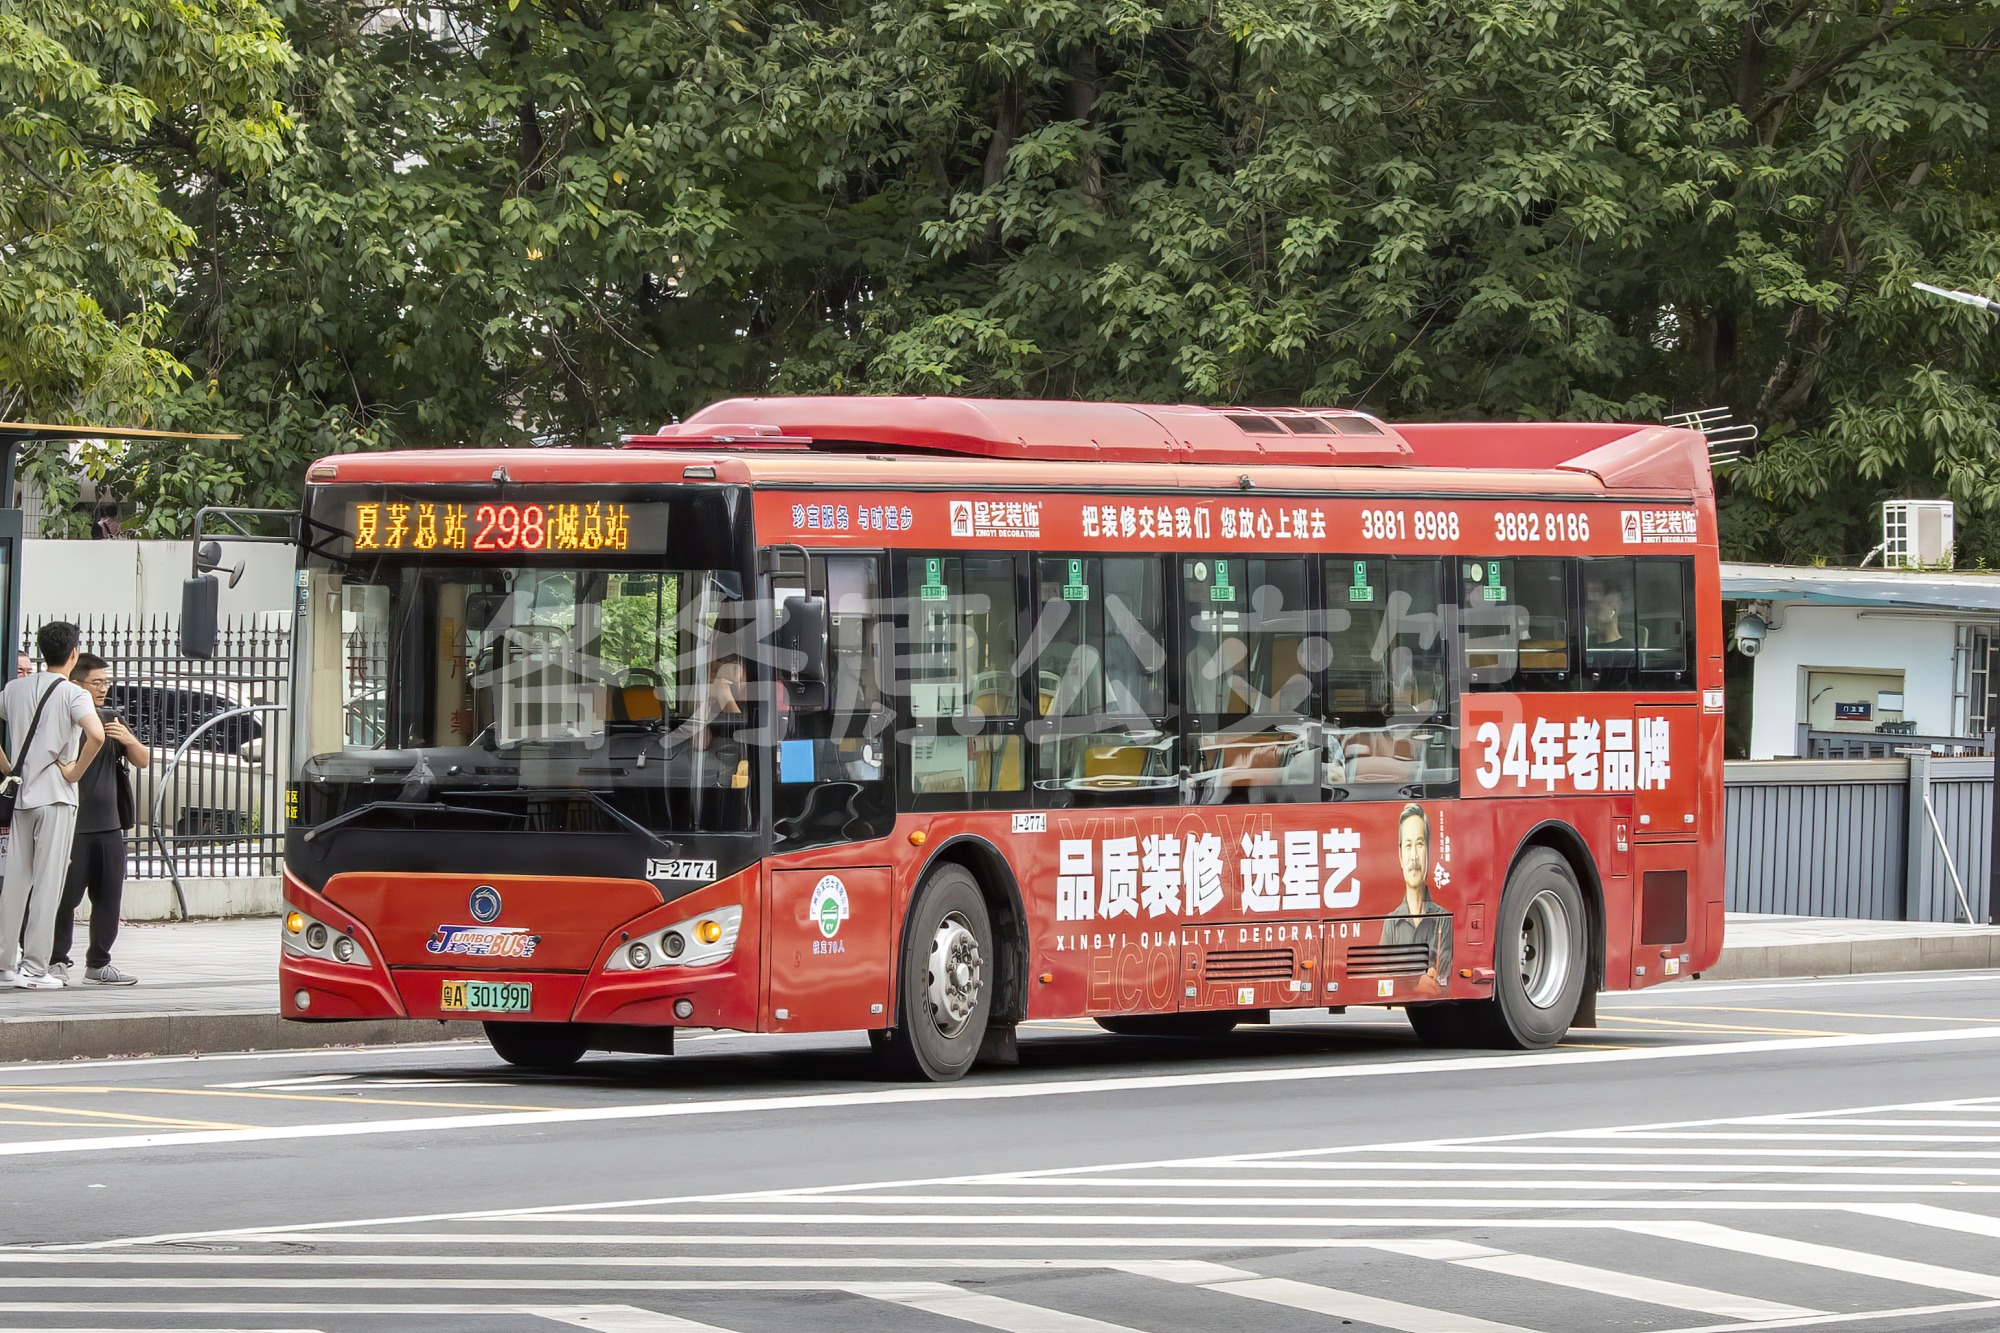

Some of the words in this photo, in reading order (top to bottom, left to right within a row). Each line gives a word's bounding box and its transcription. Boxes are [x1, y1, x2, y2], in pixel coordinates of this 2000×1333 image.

[355, 503, 468, 549] 夏茅总站
[473, 504, 546, 551] 298
[547, 503, 630, 550] 城总站
[792, 504, 850, 529] 珍宝服务
[857, 505, 913, 531] 与时进步
[974, 501, 1040, 527] 星艺装饰
[1082, 505, 1210, 539] 把装修交给我们
[1220, 507, 1326, 539] 您放心上班去
[1361, 510, 1406, 540] 3881
[1414, 511, 1460, 541] 8988
[1494, 512, 1540, 541] 3882
[1545, 513, 1590, 541] 8186
[1641, 510, 1697, 533] 星艺装饰
[975, 529, 997, 538] XINGYI
[999, 529, 1041, 538] DECORATION
[1476, 716, 1671, 791] 34年老品牌
[1012, 815, 1046, 831] J-2774
[647, 861, 716, 879] J-2774
[1056, 832, 1225, 922] 品质装修
[1240, 827, 1361, 915] 选星艺
[1056, 932, 1127, 951] XINGYI
[1141, 928, 1225, 948] QUALITY
[1239, 922, 1361, 944] DECORATION
[471, 986, 529, 1009] 30199D
